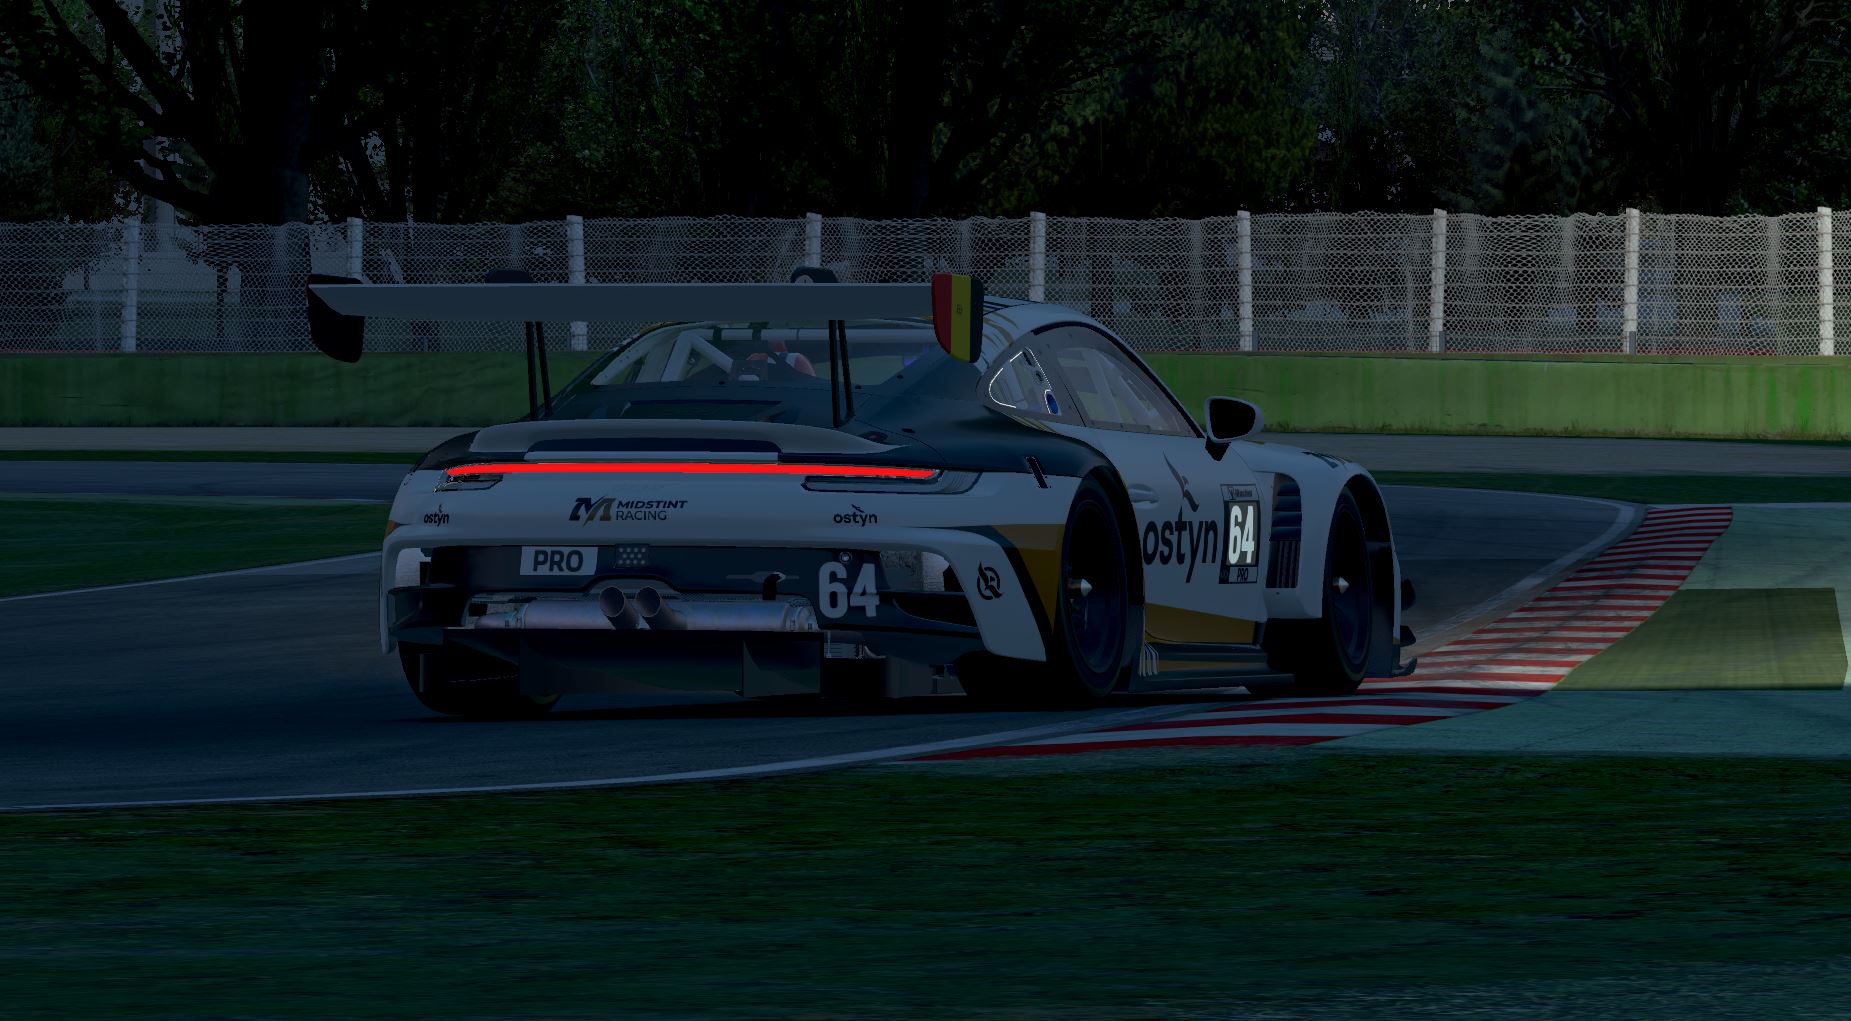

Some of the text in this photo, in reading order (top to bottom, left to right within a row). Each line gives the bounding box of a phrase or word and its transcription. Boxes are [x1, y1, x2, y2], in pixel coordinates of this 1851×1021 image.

[617, 500, 688, 509] MIDSTINT
[424, 511, 449, 526] ostyn
[616, 510, 667, 521] RACING
[833, 511, 878, 526] ostyn
[1229, 505, 1254, 564] 64
[1143, 506, 1218, 583] ostyn
[533, 550, 584, 572] PRO
[818, 561, 880, 619] 64
